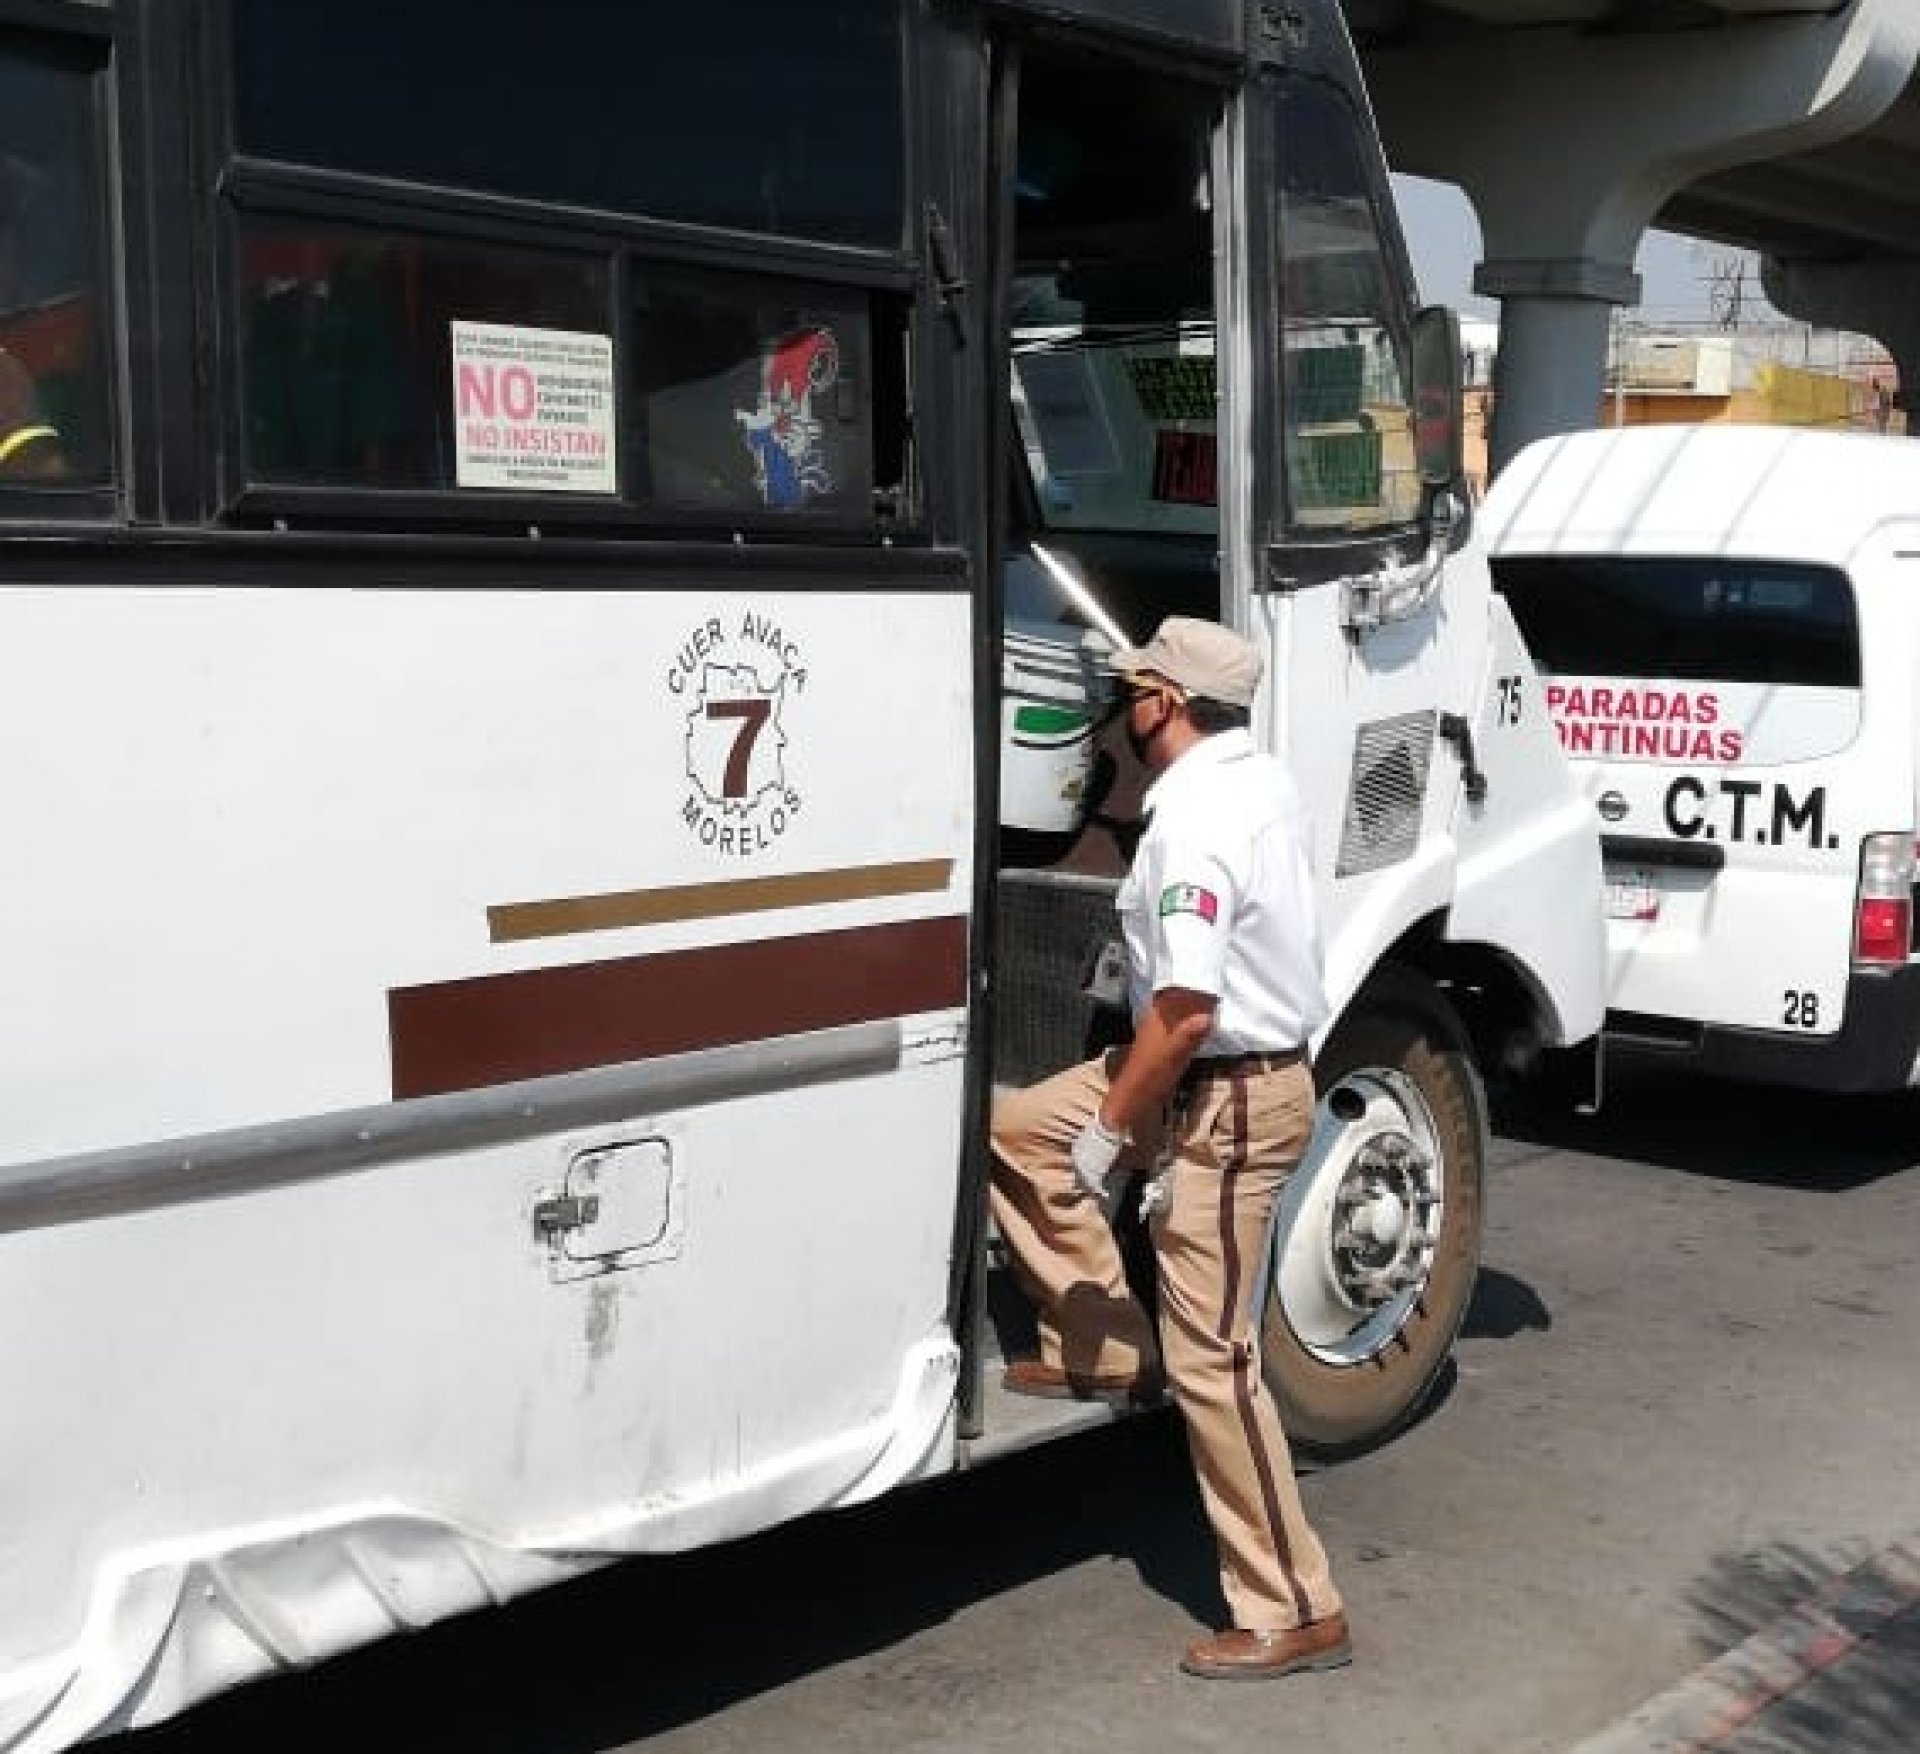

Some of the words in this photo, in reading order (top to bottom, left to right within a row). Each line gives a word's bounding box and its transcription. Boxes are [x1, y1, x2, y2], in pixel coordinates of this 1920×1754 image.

[459, 364, 536, 420] NO
[465, 424, 498, 450] NO
[1497, 675, 1523, 728] 75
[1546, 684, 1720, 726] PARADAS
[706, 699, 772, 799] 7
[682, 788, 802, 856] MORELOS
[1663, 776, 1840, 850] C.T.M.
[1783, 990, 1820, 1029] 28
